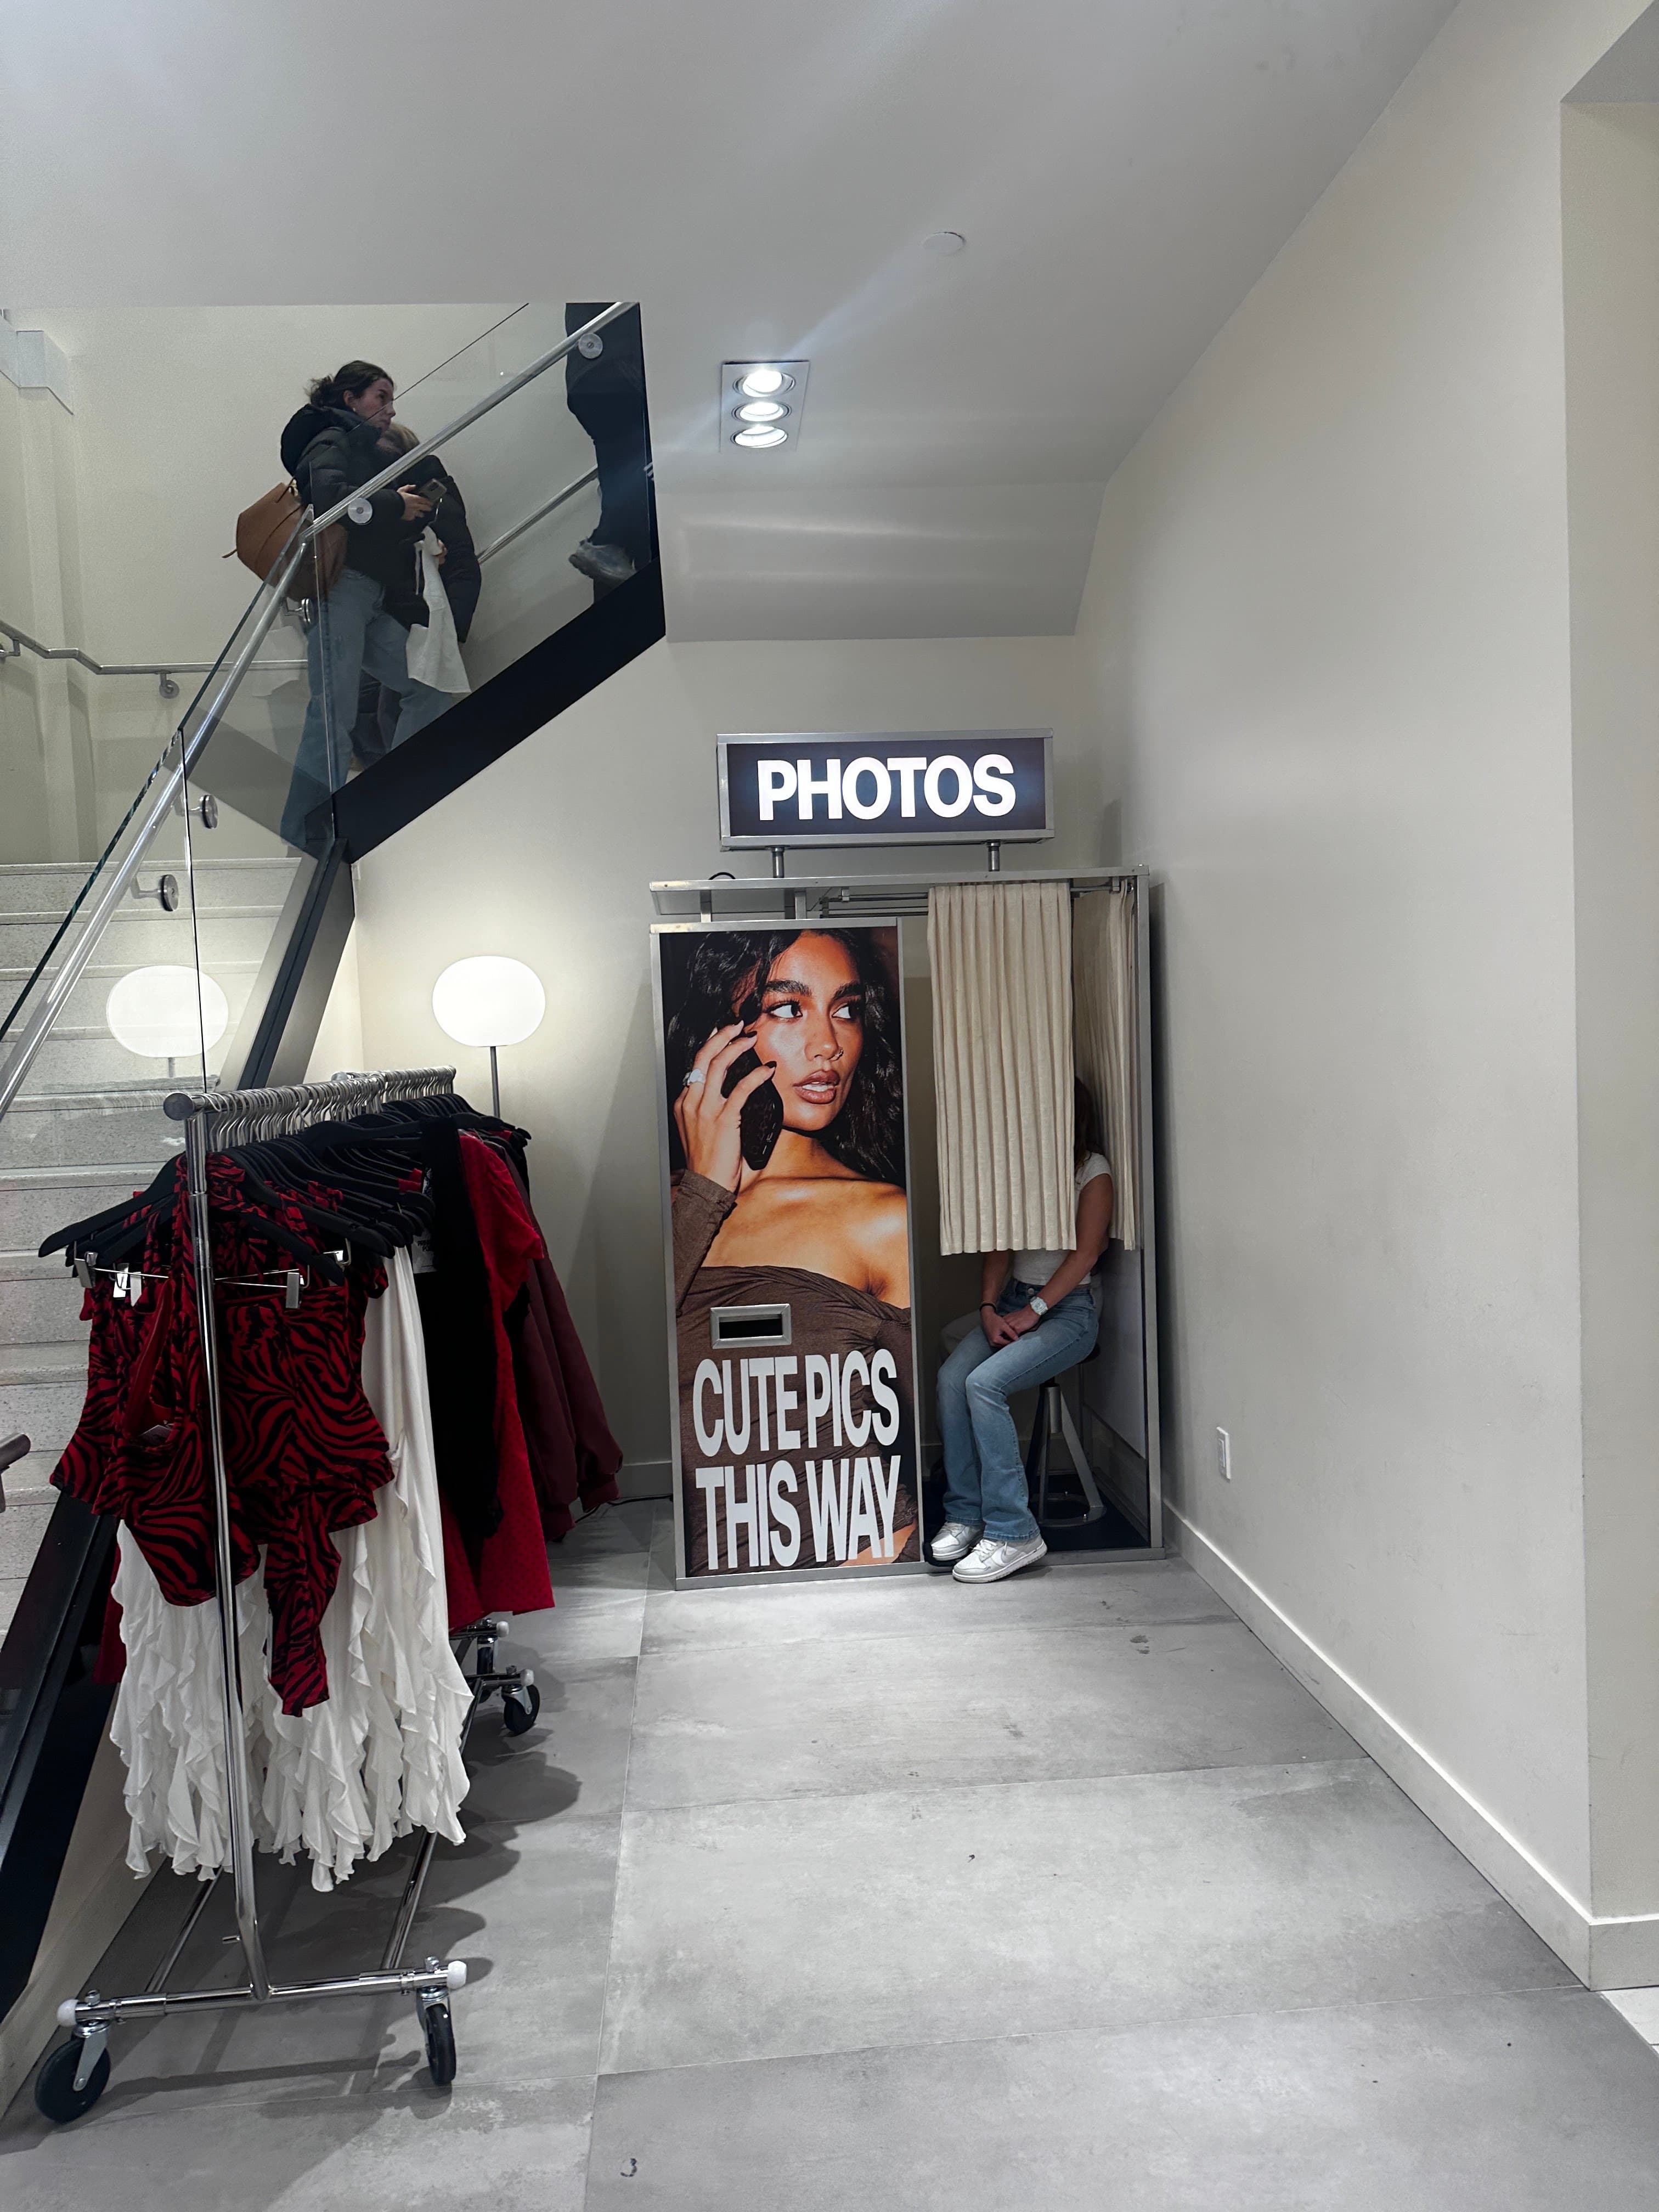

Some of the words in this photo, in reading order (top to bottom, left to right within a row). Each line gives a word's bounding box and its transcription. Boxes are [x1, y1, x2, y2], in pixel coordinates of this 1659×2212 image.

[757, 754, 1017, 821] PHOTOS
[692, 1356, 801, 1457] CUTE
[805, 1348, 900, 1448] PICS
[695, 1460, 801, 1570] THIS
[805, 1455, 901, 1562] WAY
